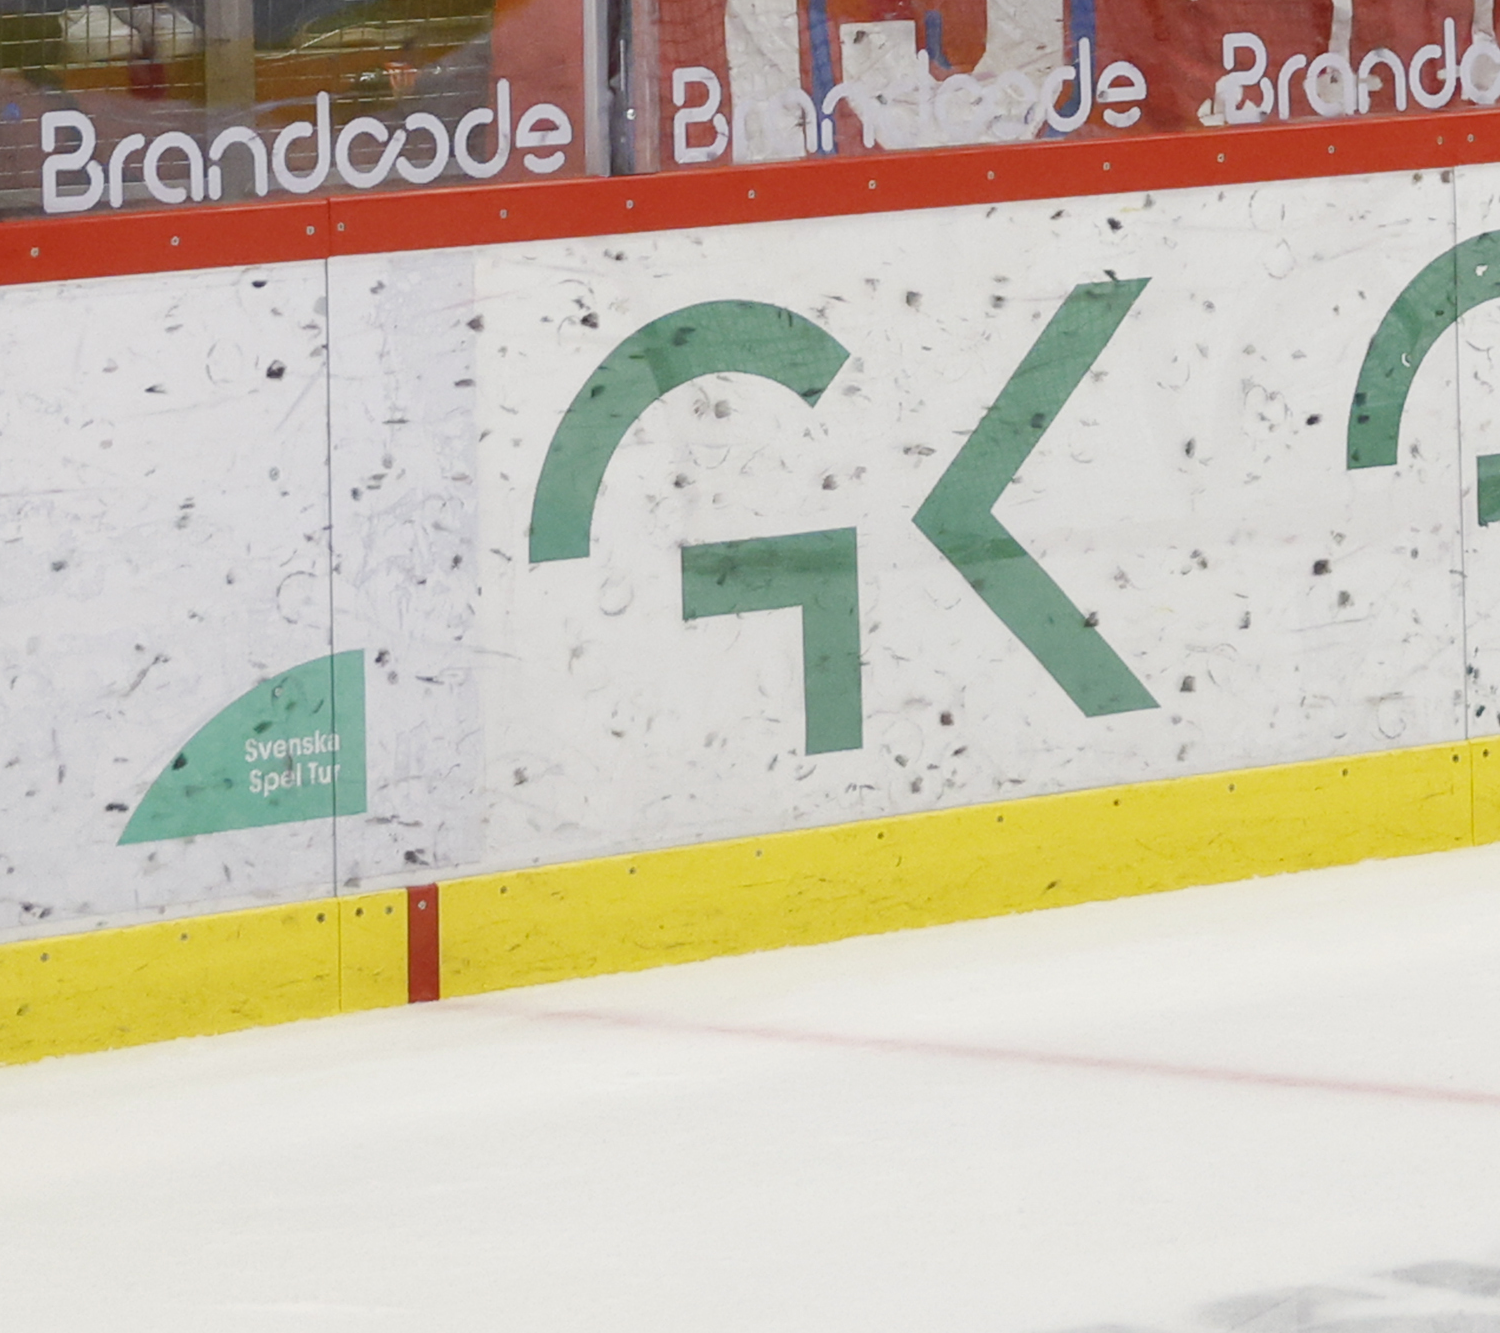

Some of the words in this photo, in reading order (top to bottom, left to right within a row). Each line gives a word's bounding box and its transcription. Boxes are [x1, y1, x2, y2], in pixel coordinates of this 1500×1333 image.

[42, 79, 573, 213] Brandcode
[243, 729, 341, 764] Svenska
[248, 764, 304, 797] Spel
